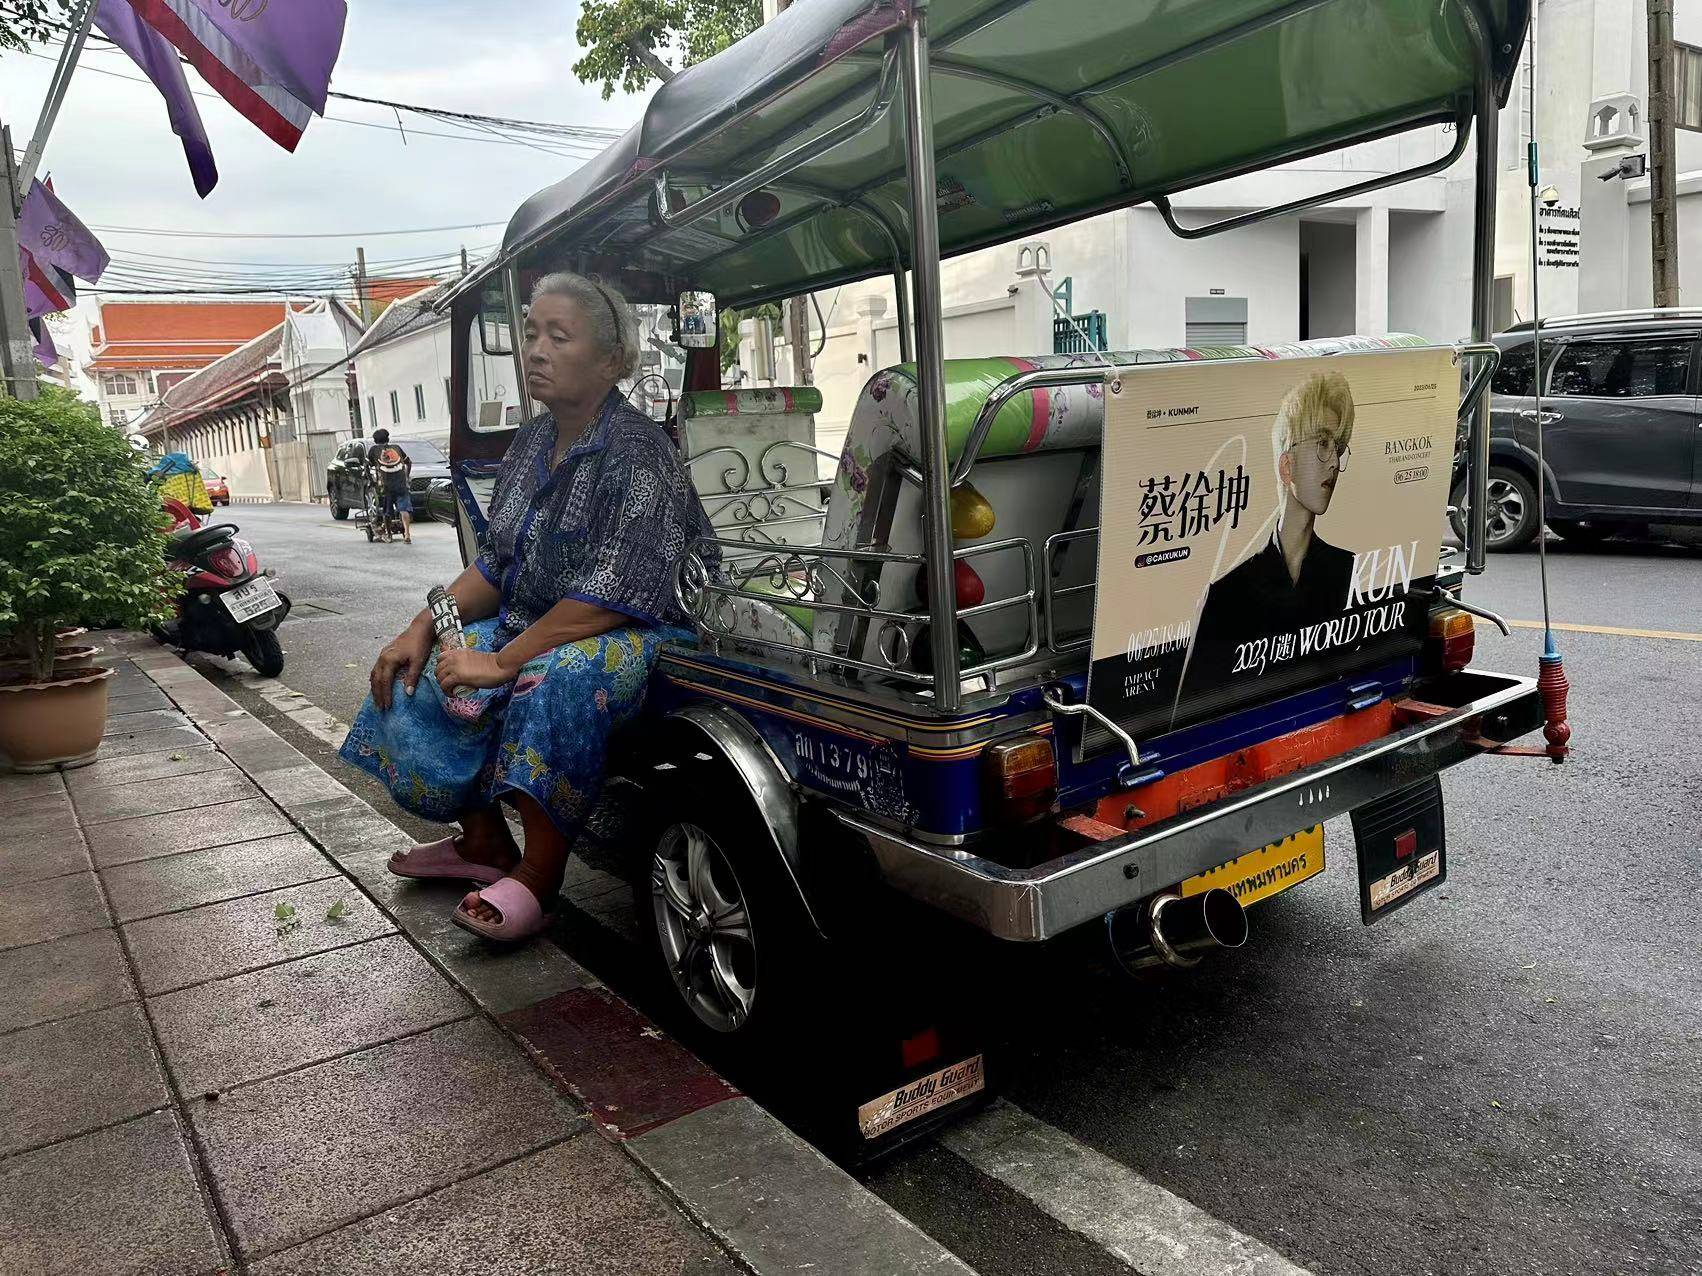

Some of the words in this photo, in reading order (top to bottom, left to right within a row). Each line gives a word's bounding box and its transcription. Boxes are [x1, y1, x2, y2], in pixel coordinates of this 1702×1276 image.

[1168, 406, 1200, 417] KUNMMT
[1384, 435, 1433, 455] BANGKOK
[1136, 464, 1250, 547] 蔡徐坤
[1146, 548, 1189, 565] @CAIXUKUN
[1343, 539, 1419, 611] KUN
[1231, 637, 1268, 676] 2023
[1299, 613, 1362, 657] WORLD
[1363, 601, 1406, 639] TOUR
[1124, 667, 1162, 687] IMPACT
[1122, 680, 1156, 699] ARENA
[893, 1077, 938, 1110] Buddy
[940, 1057, 980, 1088] Guard
[895, 1100, 930, 1123] SPORTS
